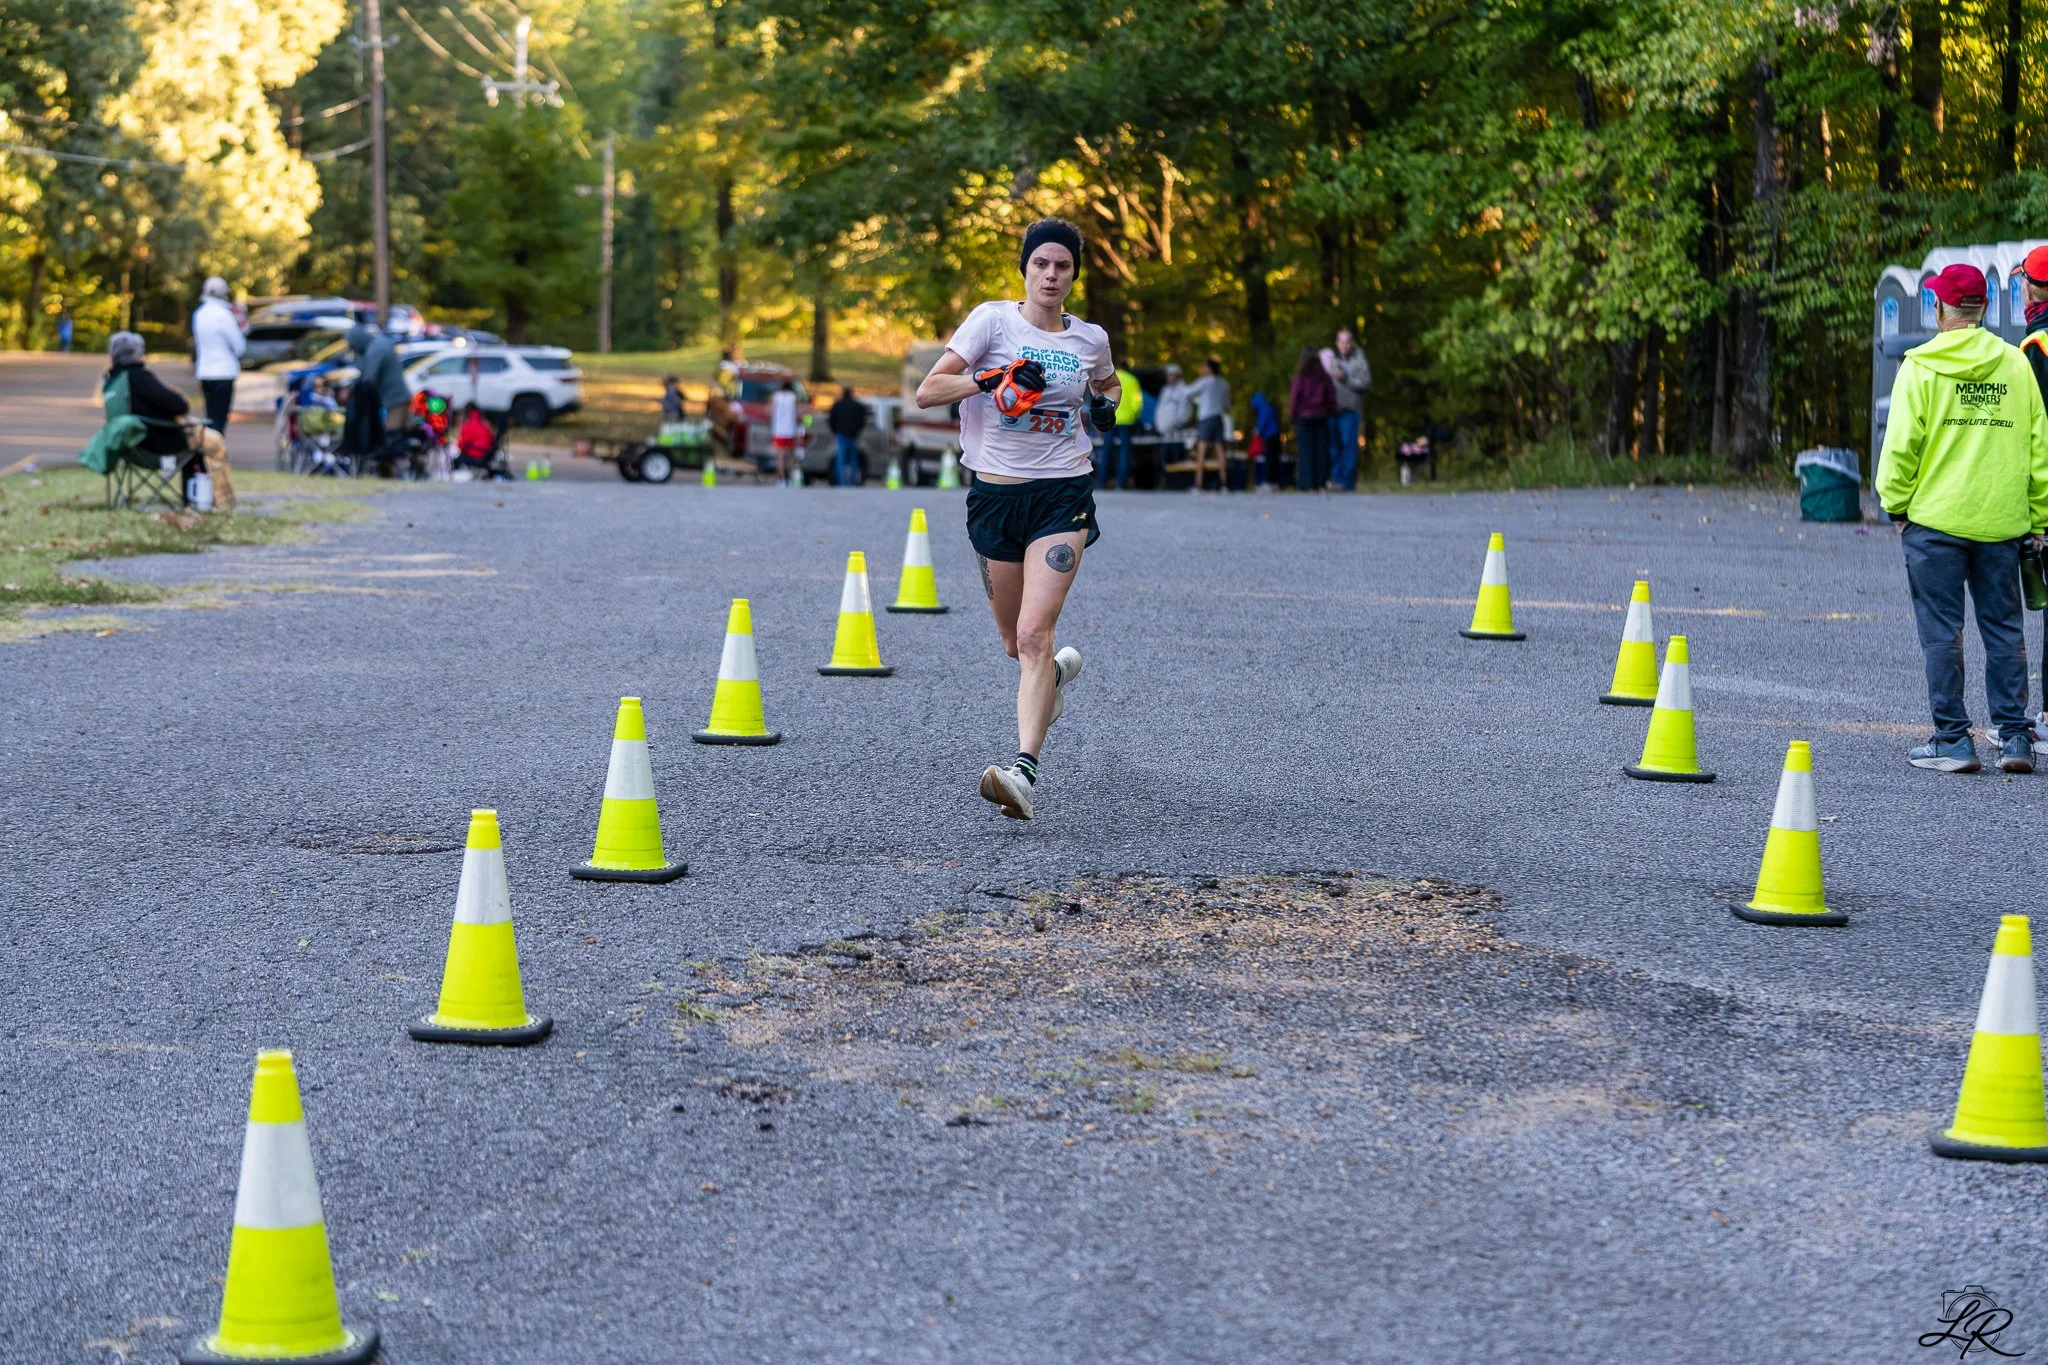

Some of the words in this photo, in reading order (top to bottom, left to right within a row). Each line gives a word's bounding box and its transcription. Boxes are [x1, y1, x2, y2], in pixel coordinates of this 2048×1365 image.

[1021, 351, 1080, 369] CHICAGO
[1050, 350, 1079, 360] AMERICA
[1040, 361, 1077, 373] RATHON
[1955, 383, 2008, 395] MEMPHIS
[1960, 394, 2001, 403] RUNNERS
[1028, 415, 1066, 434] 229
[1942, 418, 1968, 427] FINISH
[1968, 418, 1988, 426] LINE
[1989, 419, 2014, 428] CREW
